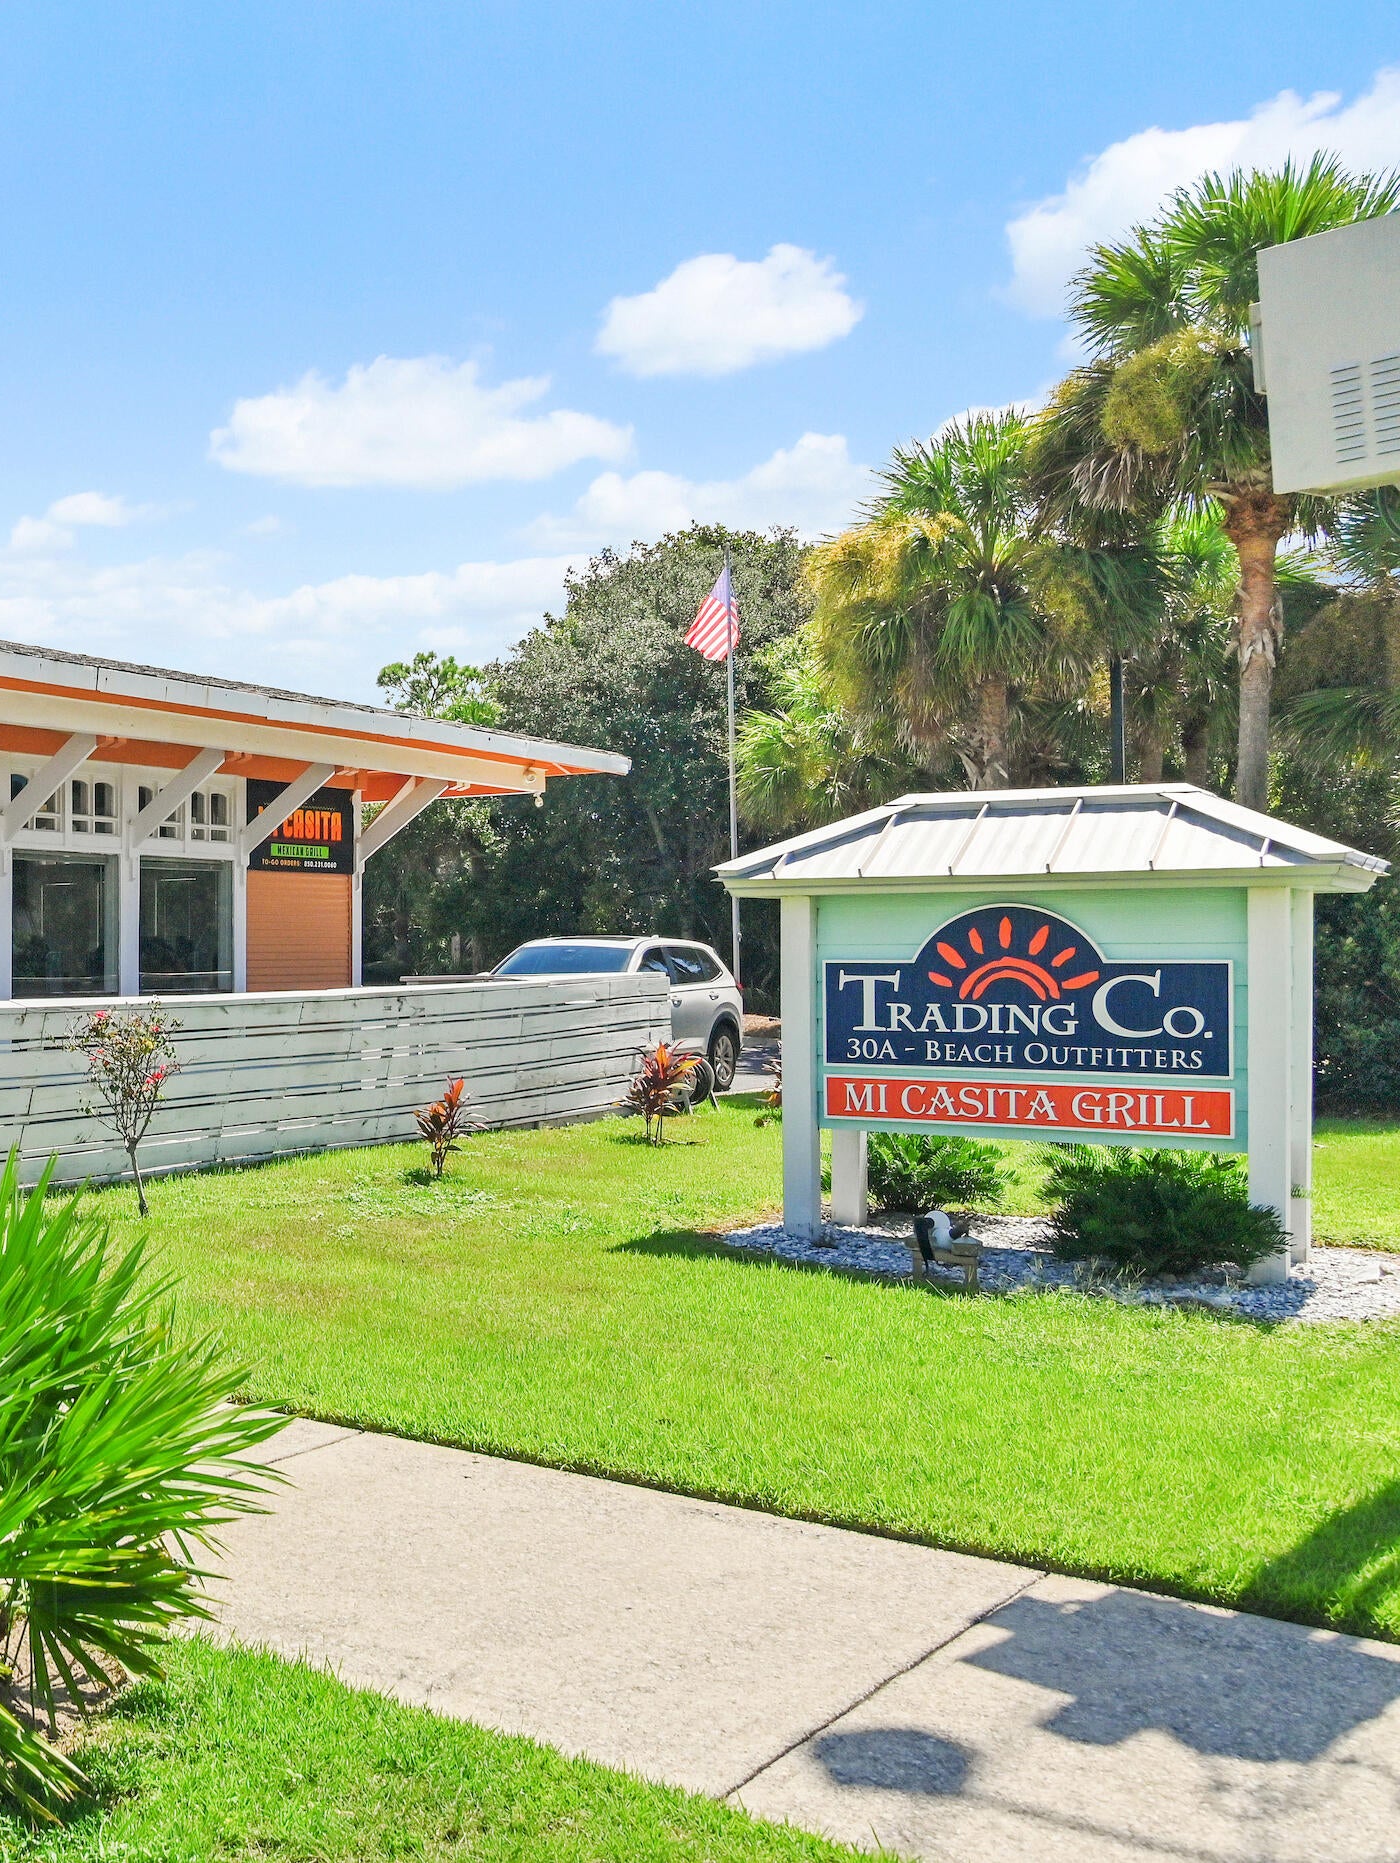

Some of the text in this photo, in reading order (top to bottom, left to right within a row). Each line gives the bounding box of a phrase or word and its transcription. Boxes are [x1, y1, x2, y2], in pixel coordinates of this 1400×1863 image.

[282, 808, 343, 842] CASITA
[261, 858, 280, 866] TO-GO
[277, 844, 322, 857] MEXICAN GRILL
[838, 969, 1080, 1036] TRADING
[846, 1037, 898, 1061] 30A
[924, 1040, 1019, 1064] BEACH
[1023, 1042, 1204, 1070] OUTFITTERS
[843, 1082, 1212, 1129] MI CASITA GRILL
